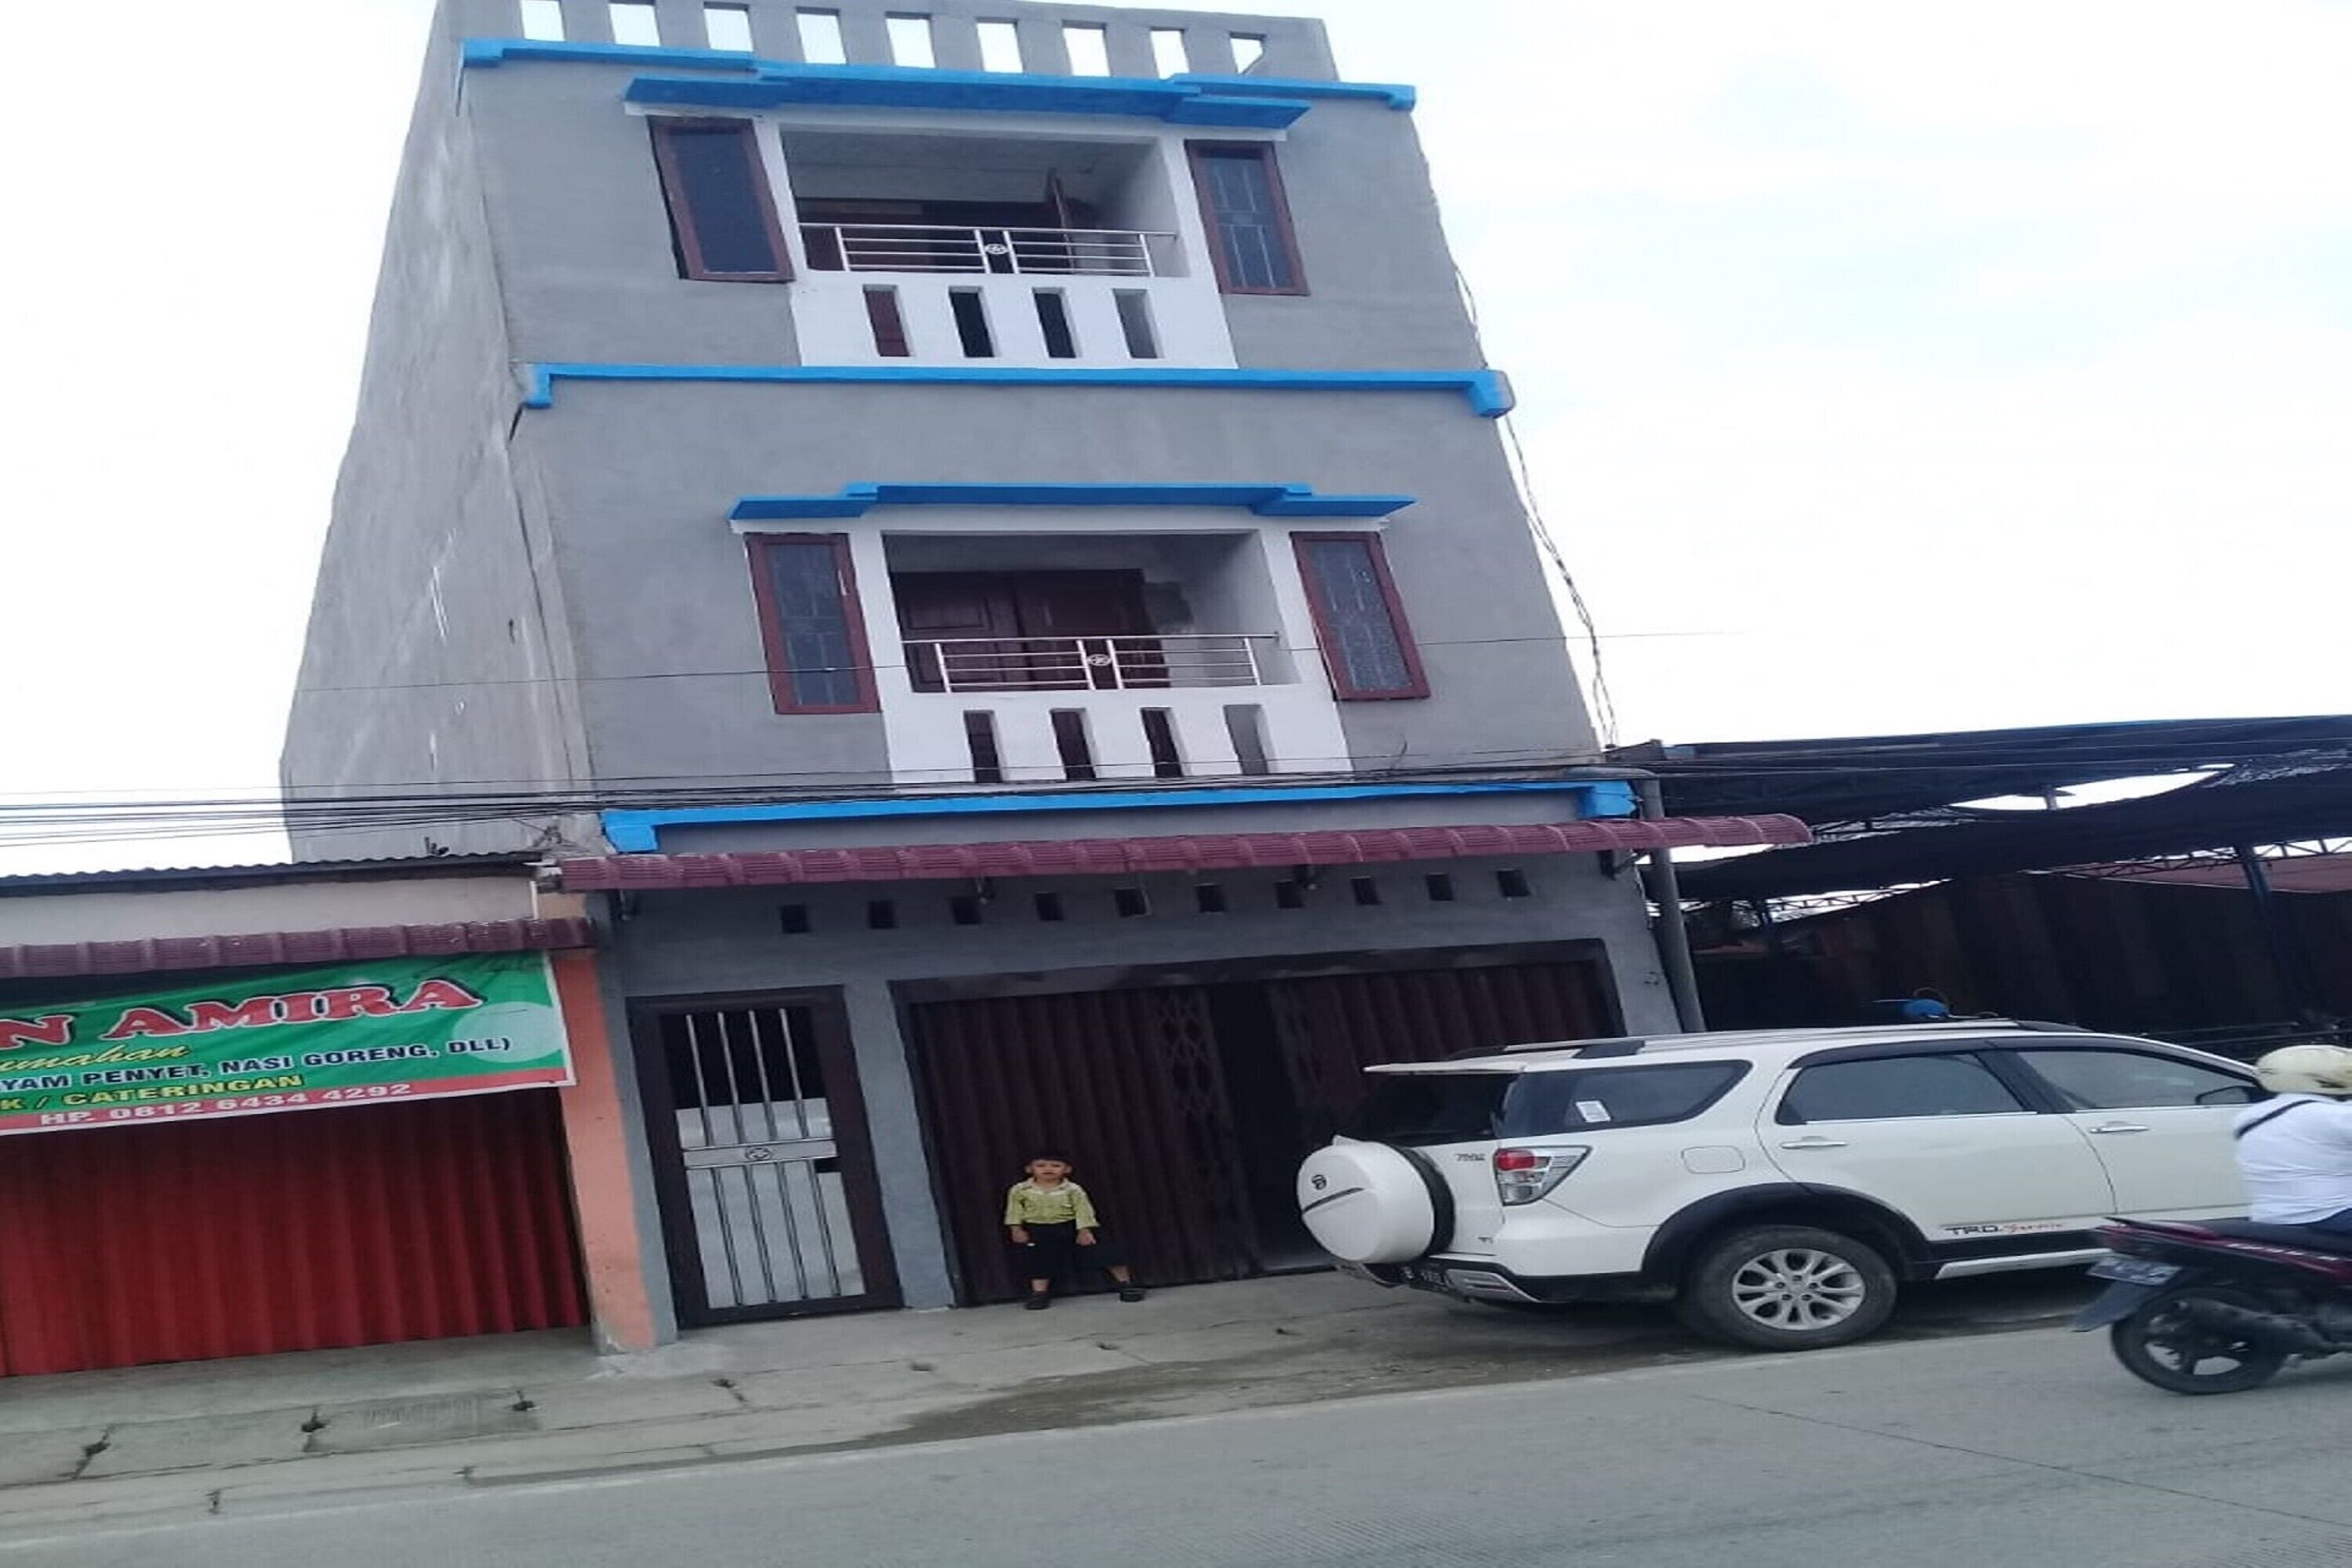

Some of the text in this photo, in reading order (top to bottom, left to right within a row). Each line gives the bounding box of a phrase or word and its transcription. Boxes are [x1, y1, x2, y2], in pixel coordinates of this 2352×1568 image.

[98, 979, 483, 1040] AMIRA
[0, 1074, 71, 1092] YAM
[220, 1056, 293, 1075] NASI
[447, 1036, 511, 1054] DLL)
[63, 1075, 303, 1106] CATERINGAN
[110, 1100, 204, 1119] 0812
[216, 1092, 308, 1111] 6434
[321, 1083, 412, 1102] 4292
